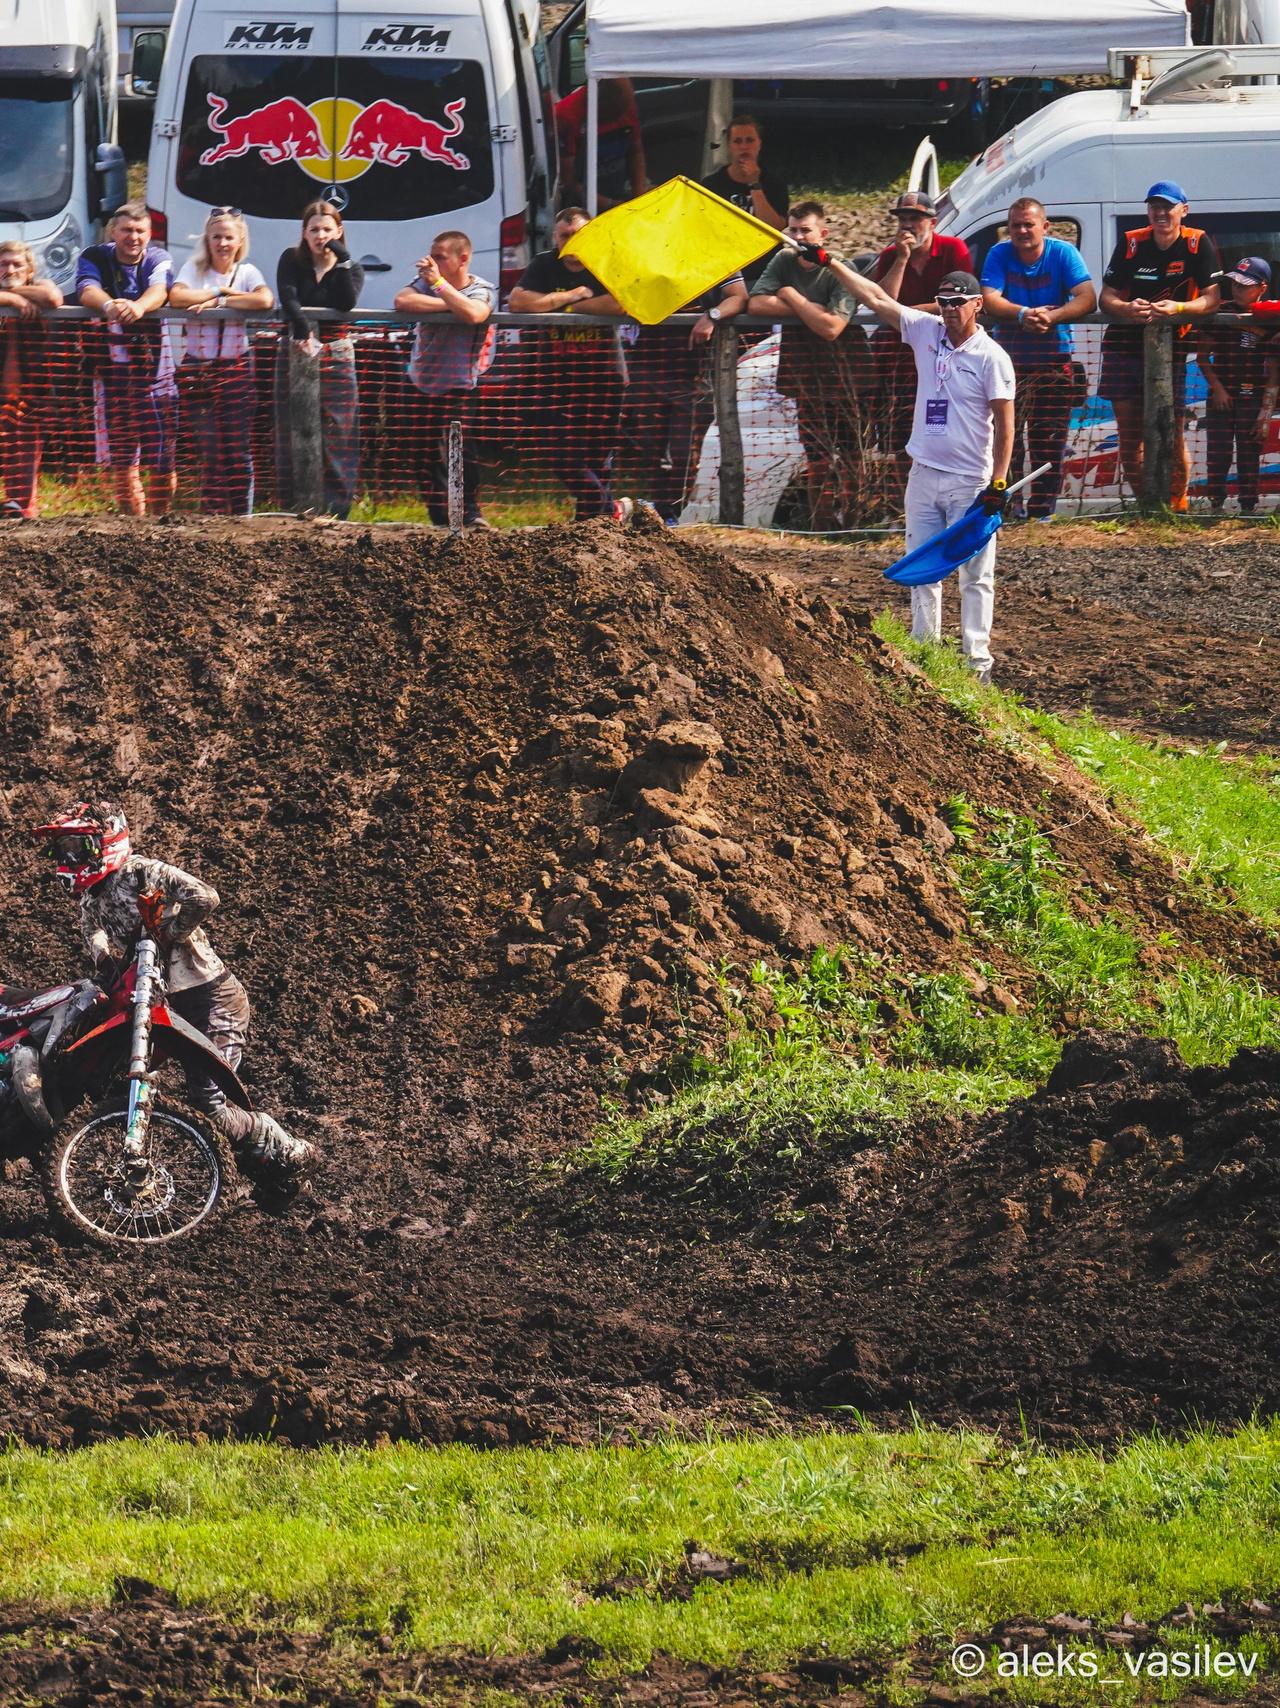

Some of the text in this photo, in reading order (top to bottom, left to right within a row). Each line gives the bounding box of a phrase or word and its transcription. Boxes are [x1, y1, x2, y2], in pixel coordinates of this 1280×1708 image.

[228, 21, 314, 44] KTM
[365, 24, 452, 47] KTM
[223, 42, 309, 50] RACING
[360, 44, 446, 53] RACING
